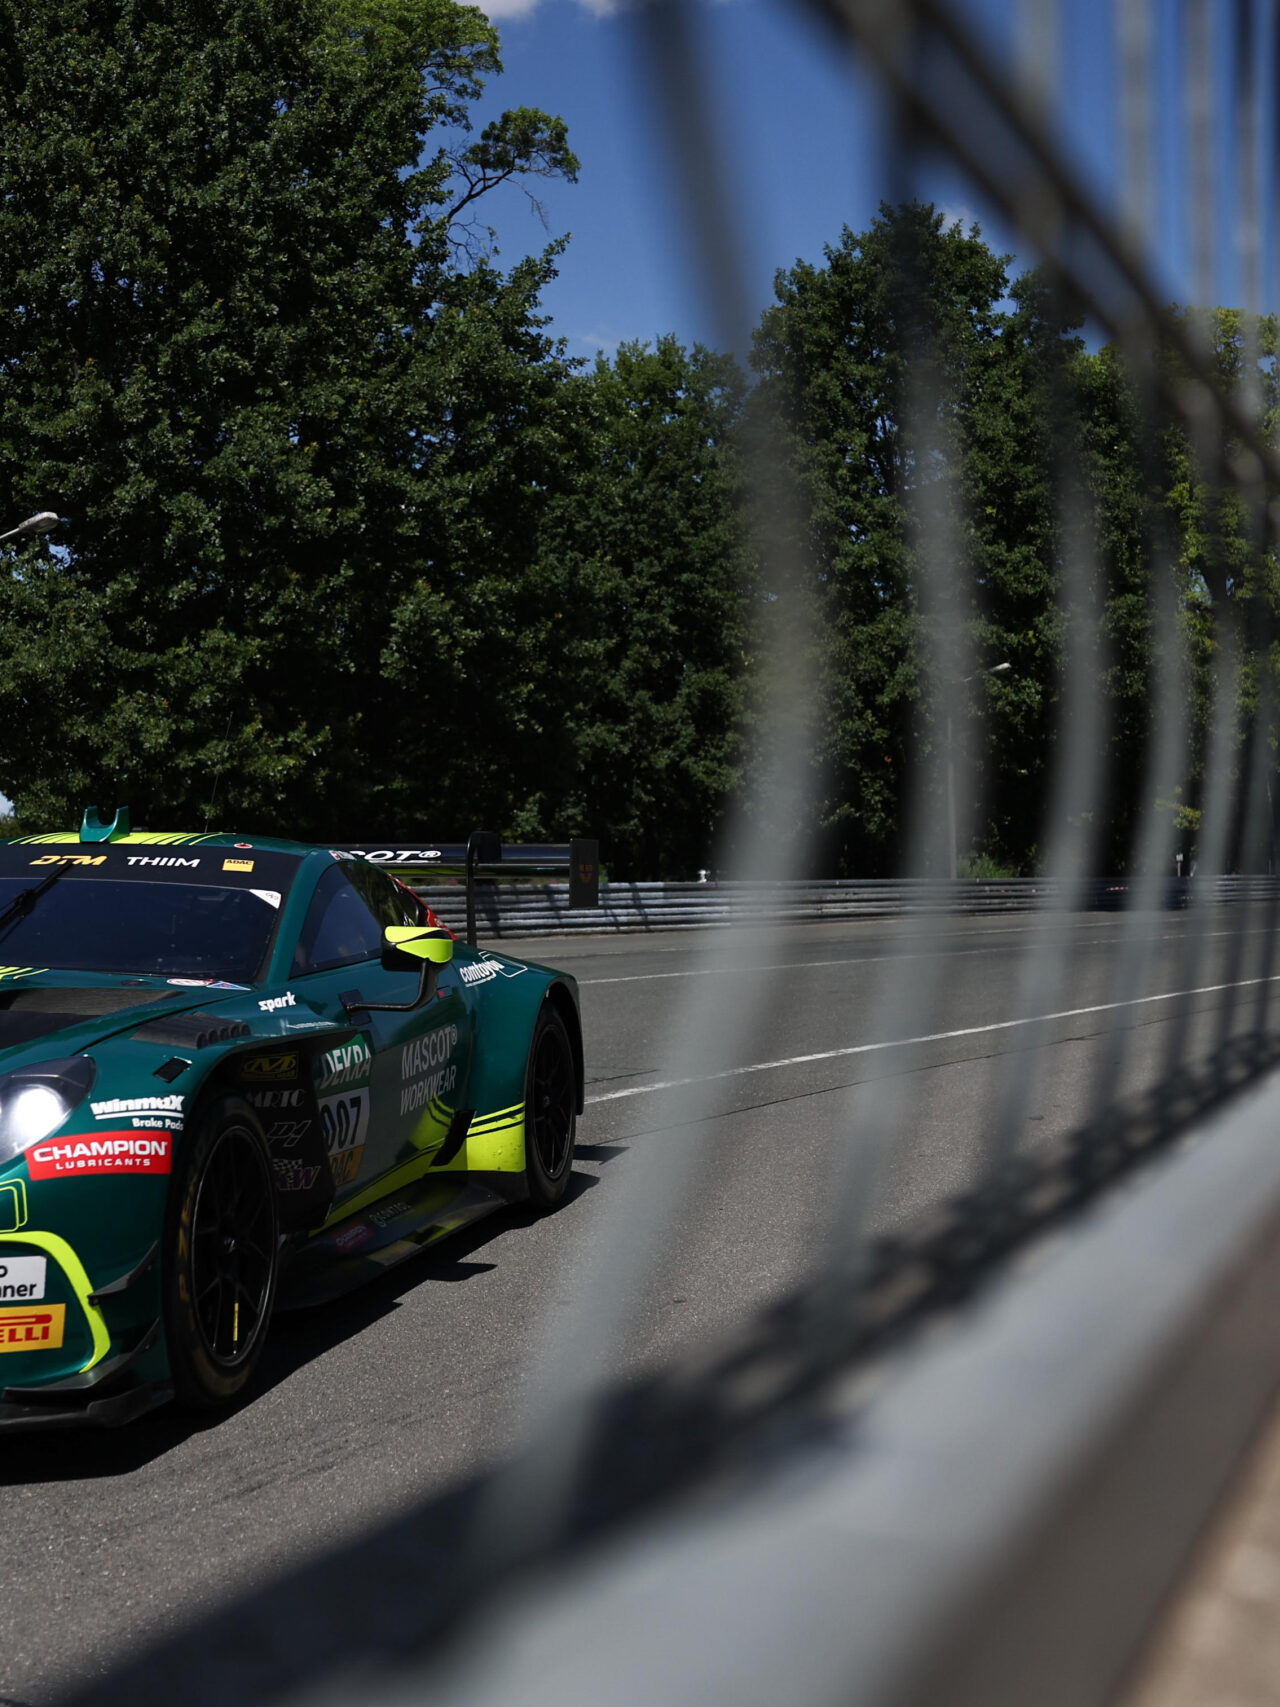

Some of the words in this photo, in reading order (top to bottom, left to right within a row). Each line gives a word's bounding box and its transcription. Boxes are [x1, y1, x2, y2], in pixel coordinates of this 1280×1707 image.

[29, 856, 107, 866] DTM
[126, 856, 200, 868] THIIM
[258, 991, 297, 1012] spark
[320, 1043, 372, 1088] DEKRA
[400, 1065, 457, 1116] WORKWEAR
[132, 1118, 163, 1129] Brake
[165, 1118, 184, 1131] Pads
[320, 1096, 362, 1152] 007
[33, 1140, 167, 1163] CHAMPION
[55, 1158, 151, 1170] LUBRICANTS
